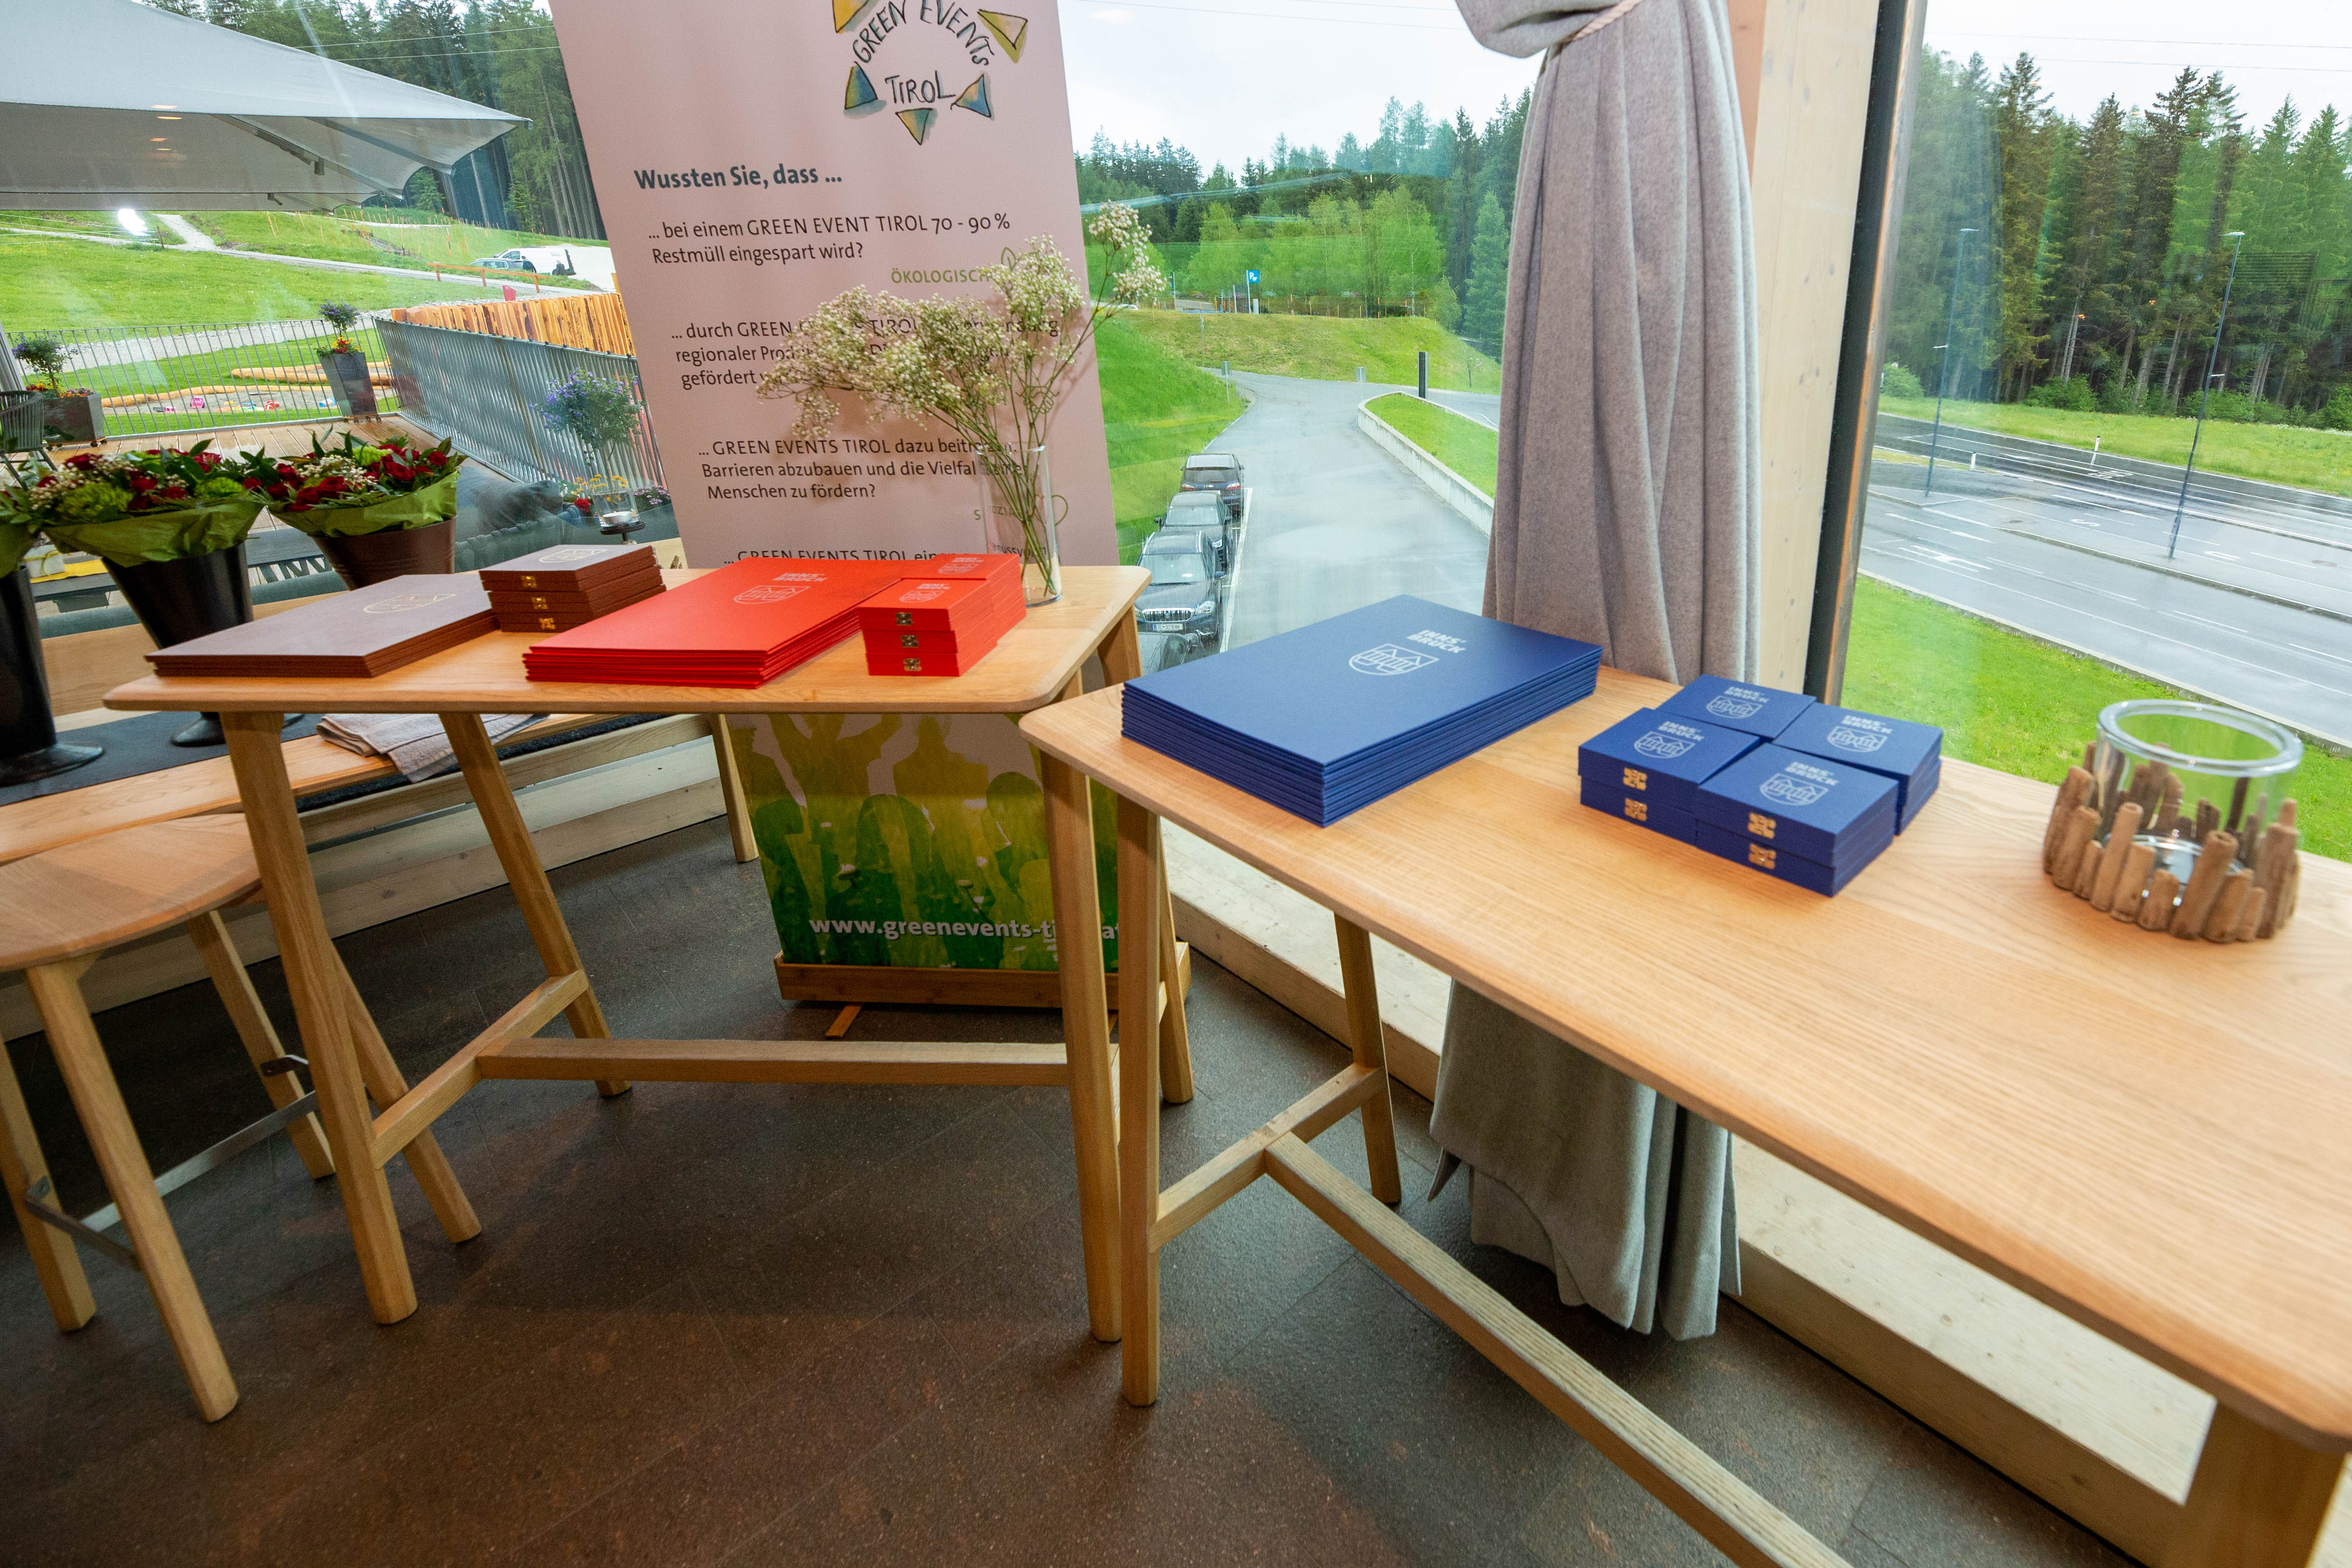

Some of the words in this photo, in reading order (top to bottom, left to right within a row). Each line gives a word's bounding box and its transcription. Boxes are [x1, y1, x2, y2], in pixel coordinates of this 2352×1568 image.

[852, 0, 906, 63] GREEN
[920, 0, 995, 66] EVENTS
[885, 70, 956, 104] TIROL
[634, 168, 726, 189] Wussten
[730, 165, 768, 189] Sie,
[773, 163, 819, 184] dass
[663, 222, 689, 238] bei
[693, 222, 743, 238] einem
[747, 219, 808, 236] GREEN
[814, 217, 870, 234] EVENT
[876, 215, 927, 232] TIROL
[931, 218, 952, 235] 70
[969, 217, 991, 234] 90
[994, 213, 1010, 230] %
[652, 245, 725, 264] Restmüll
[729, 243, 816, 266] eingespart
[819, 242, 863, 259] wird?
[687, 322, 733, 339] durch
[737, 321, 793, 337] GREEN
[676, 346, 757, 367] regionaler
[681, 369, 757, 390] gefördert
[713, 440, 770, 455] GREEN
[776, 439, 838, 454] EVENTS
[842, 439, 890, 454] TIROL
[895, 438, 934, 453] dazu
[702, 463, 774, 478] Barrieren
[778, 462, 862, 477] abzubauen
[867, 461, 896, 476] und
[901, 461, 925, 475] die
[927, 460, 976, 475] Vielfal
[708, 484, 787, 499] Menschen
[790, 487, 808, 498] zu
[811, 483, 875, 498] fördern?
[1406, 633, 1466, 653] BRUCK
